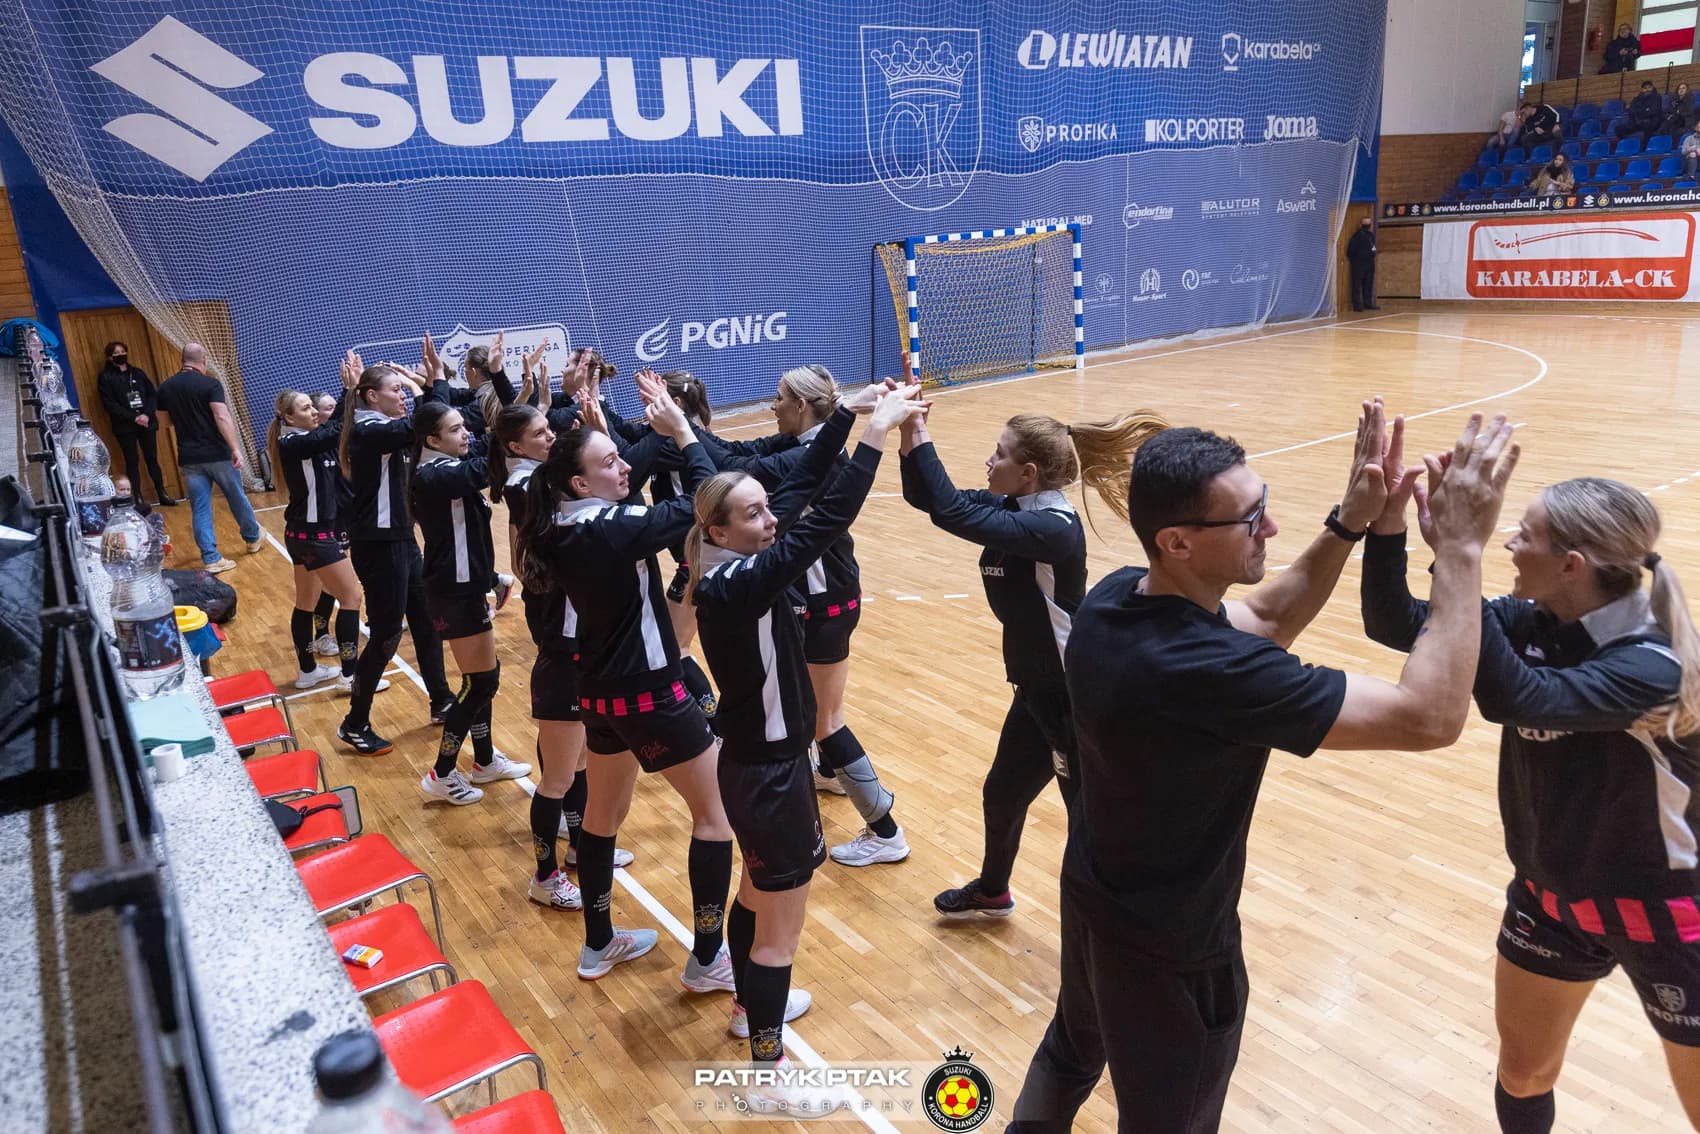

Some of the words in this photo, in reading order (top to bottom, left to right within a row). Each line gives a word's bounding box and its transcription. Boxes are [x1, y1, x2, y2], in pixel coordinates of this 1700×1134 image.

[1058, 29, 1193, 68] LEWIATAN
[1244, 38, 1313, 60] karabela
[303, 52, 804, 150] SUZUKI
[1046, 123, 1118, 143] PROFIKA
[1155, 117, 1245, 142] KOLPORTER
[881, 101, 965, 190] CK
[1210, 198, 1260, 211] ALUTOR
[1276, 198, 1317, 214] Aswent
[1433, 197, 1550, 213] www.koronahandball.pl
[1475, 269, 1677, 289] KARABELA-CK
[681, 312, 788, 353] PGNiG
